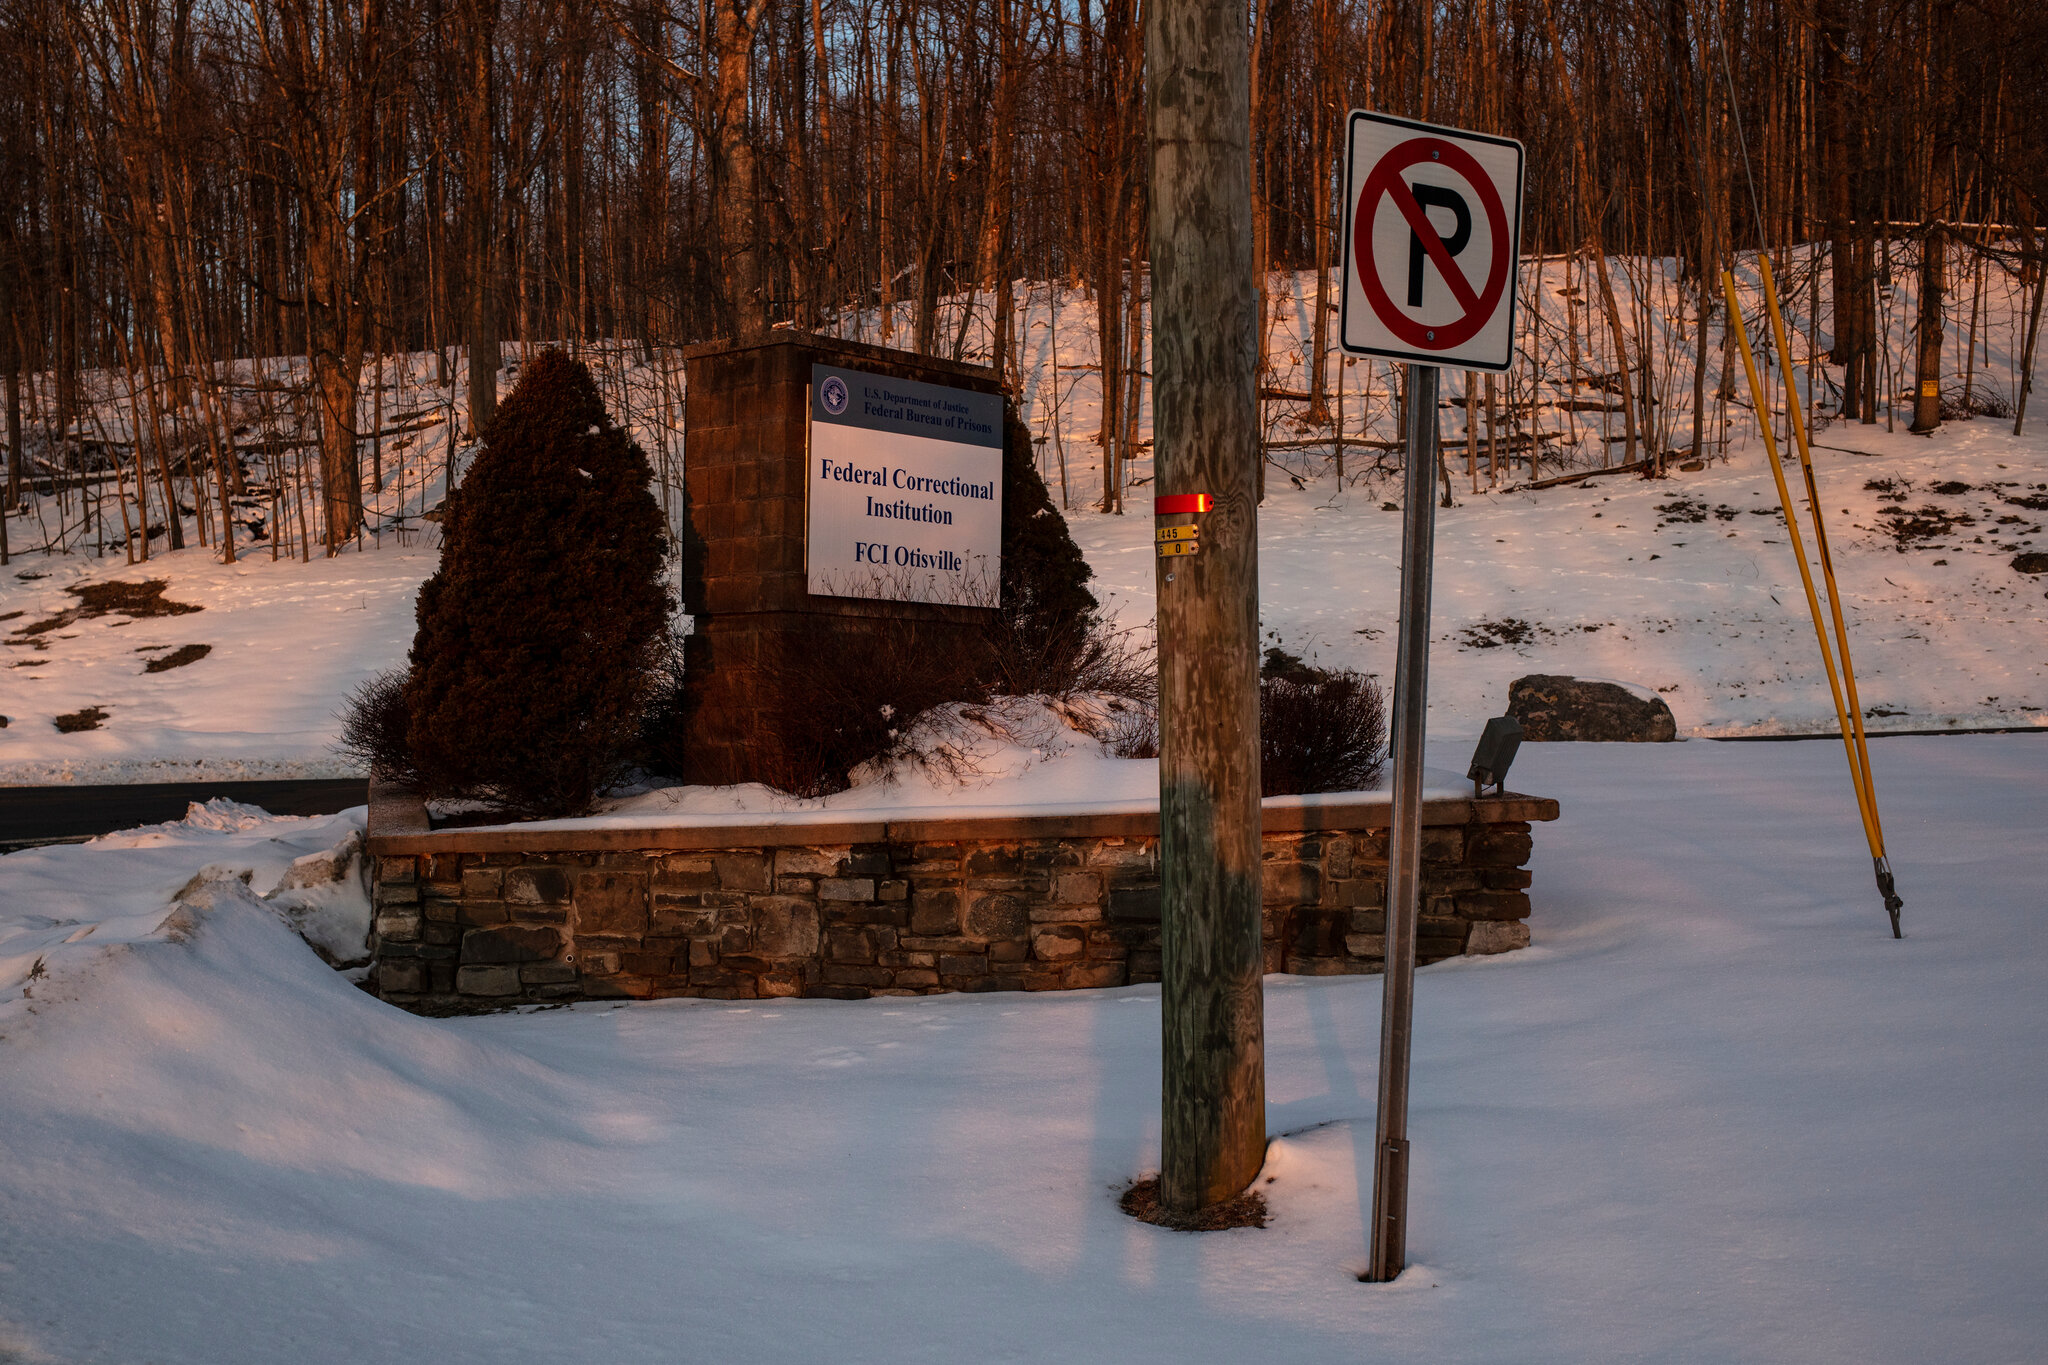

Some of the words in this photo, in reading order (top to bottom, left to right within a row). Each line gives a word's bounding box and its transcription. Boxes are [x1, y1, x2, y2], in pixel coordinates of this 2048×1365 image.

[1407, 182, 1472, 308] P
[864, 387, 881, 400] U.S.
[883, 390, 931, 408] Department
[933, 400, 942, 410] of
[942, 401, 969, 415] Justice
[864, 401, 903, 420] Federal
[906, 408, 942, 425] Bureau
[944, 416, 955, 429] of
[957, 417, 992, 434] Prisons
[820, 458, 887, 487] Federal
[892, 468, 994, 501] Correctional
[866, 495, 953, 525] Institution
[855, 541, 889, 565] FCI
[894, 545, 962, 572] Otisville
